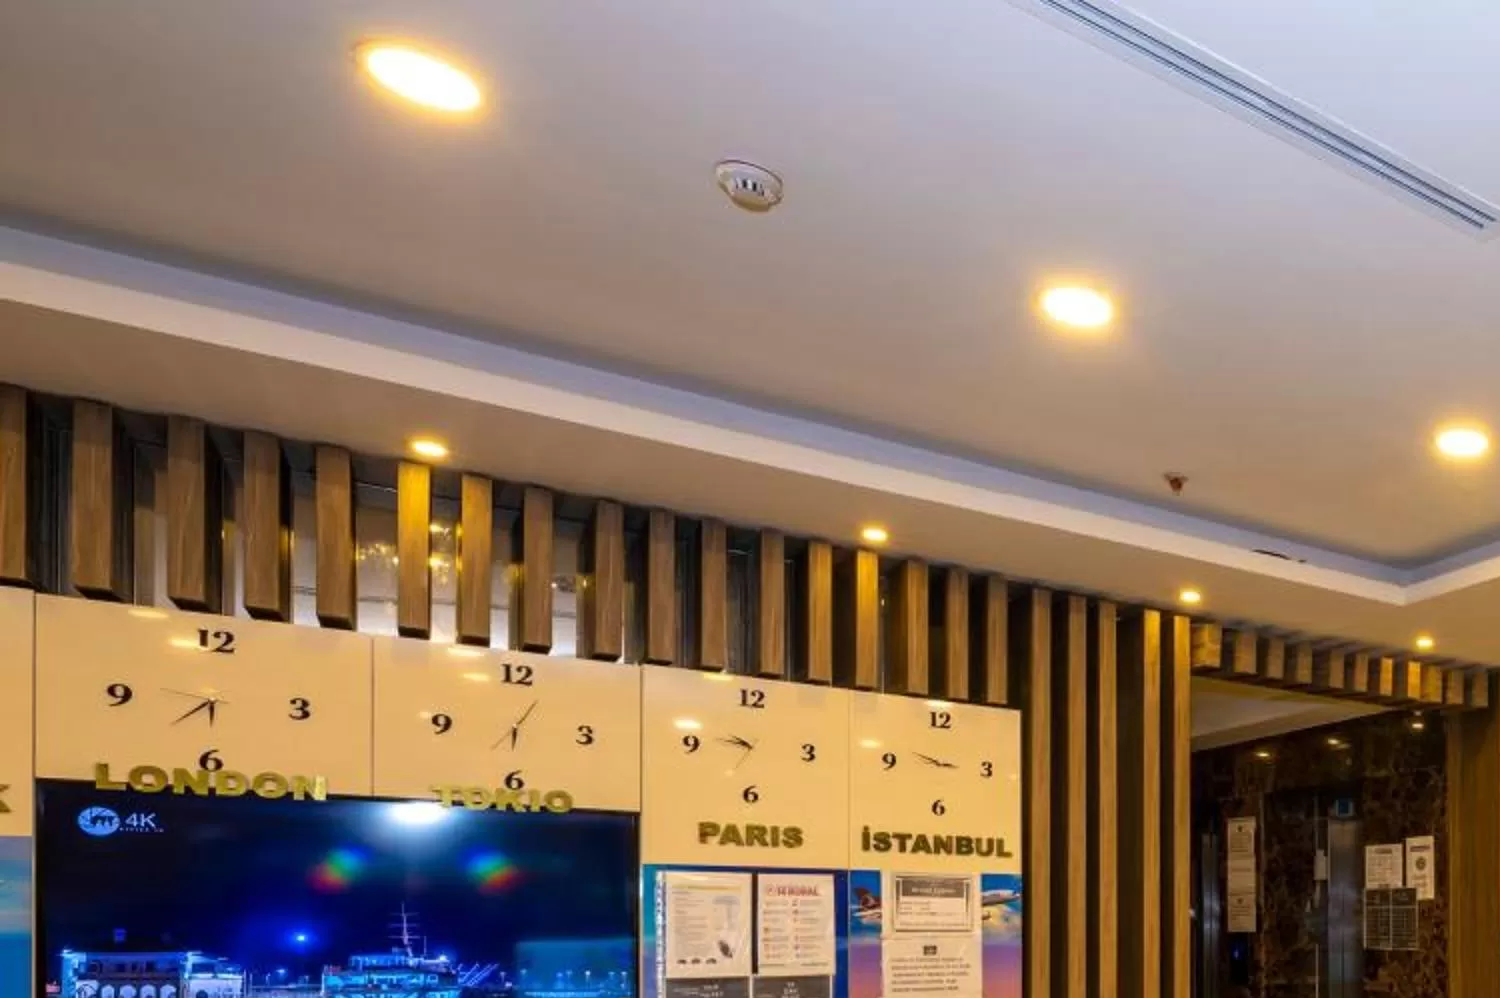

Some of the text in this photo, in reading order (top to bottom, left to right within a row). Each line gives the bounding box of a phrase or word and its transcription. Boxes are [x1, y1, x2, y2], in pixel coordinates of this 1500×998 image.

[197, 628, 236, 654] 12
[501, 663, 533, 686] 12
[107, 683, 133, 707] 9
[739, 688, 765, 709] 12
[289, 697, 311, 720] 3
[431, 713, 453, 735] 9
[930, 711, 951, 729] 12
[575, 724, 594, 745] 3
[682, 735, 701, 755] 9
[199, 749, 223, 772] 6
[801, 743, 816, 763] 3
[882, 752, 896, 771] 9
[504, 770, 524, 790] 6
[980, 761, 993, 778] 3
[95, 762, 328, 801] LONDON
[430, 784, 574, 814] TOKIO
[743, 785, 759, 804] 6
[931, 799, 945, 816] 6
[125, 812, 156, 828] 4K
[697, 821, 804, 848] PARIS
[861, 825, 1013, 858] İSTANBUL
